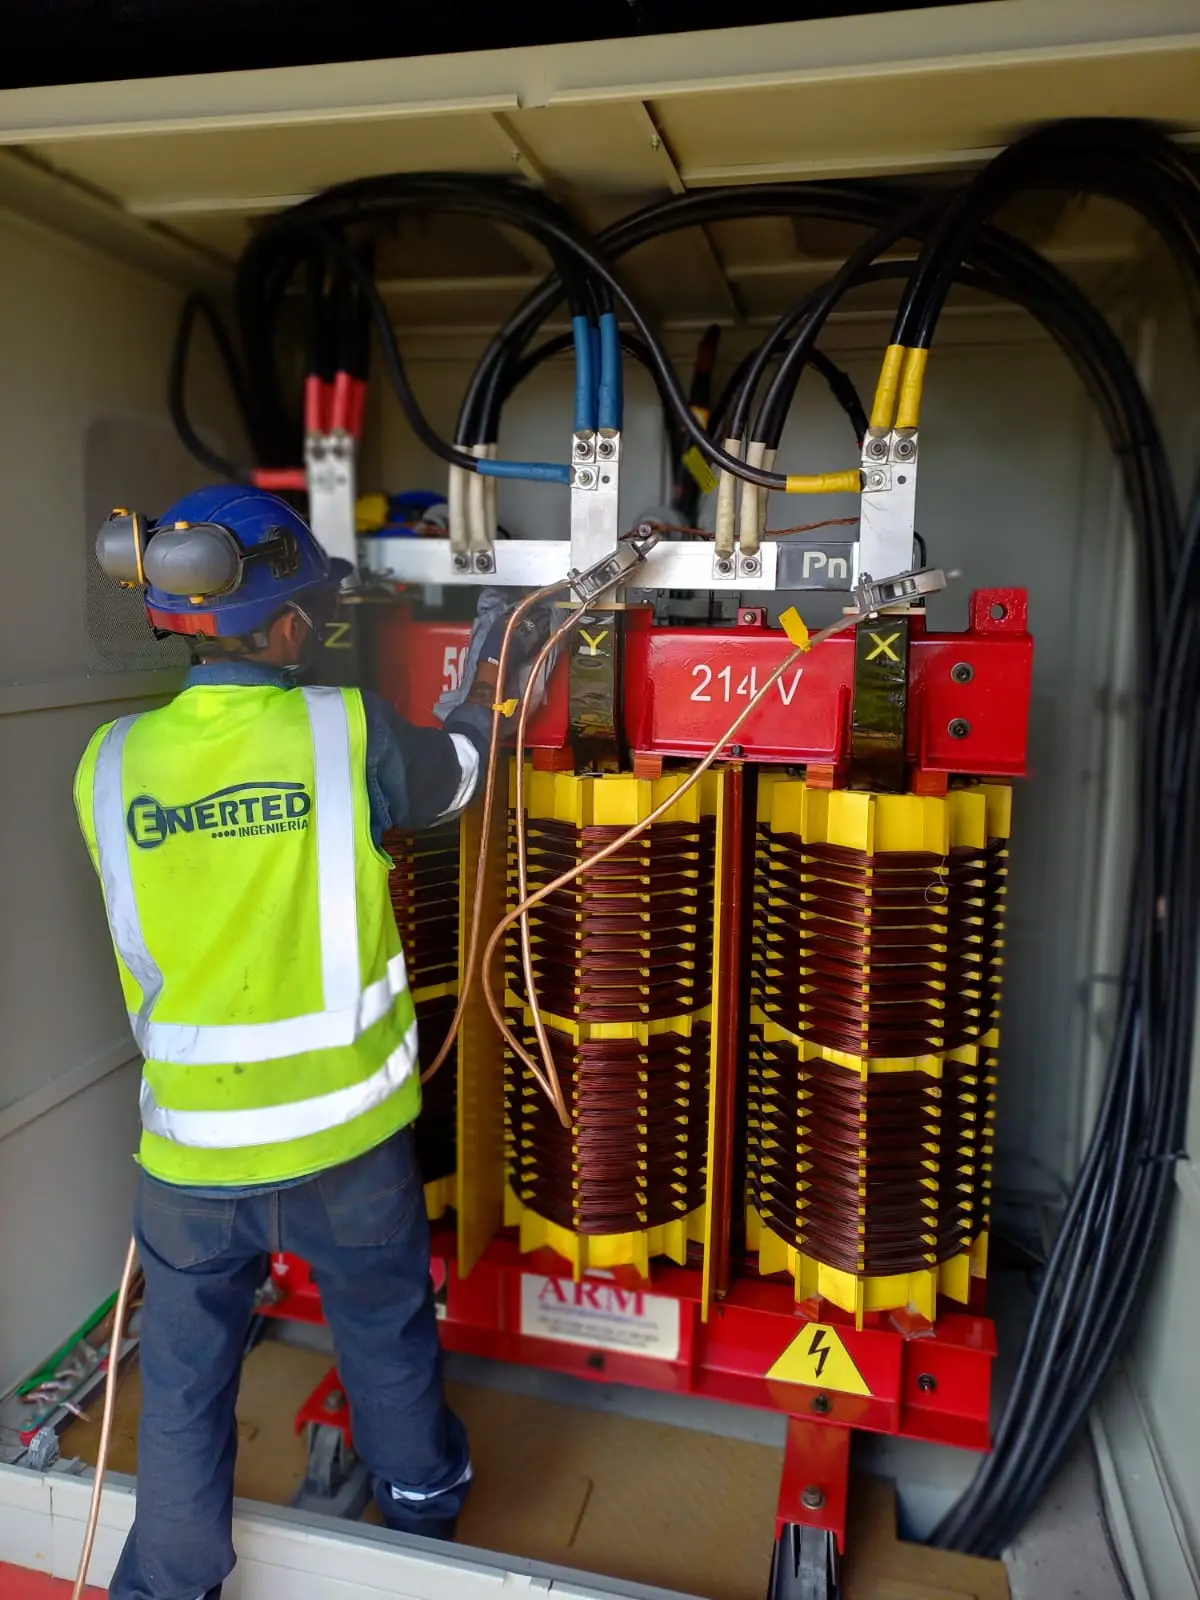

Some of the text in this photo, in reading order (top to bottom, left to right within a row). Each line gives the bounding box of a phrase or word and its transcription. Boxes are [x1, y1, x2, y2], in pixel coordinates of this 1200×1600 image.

[802, 551, 847, 579] Pn
[324, 622, 353, 647] Z
[579, 629, 609, 656] Y
[865, 632, 902, 661] X
[690, 664, 804, 705] 214 V
[128, 792, 311, 848] ENERTED
[538, 1278, 645, 1317] ARM
